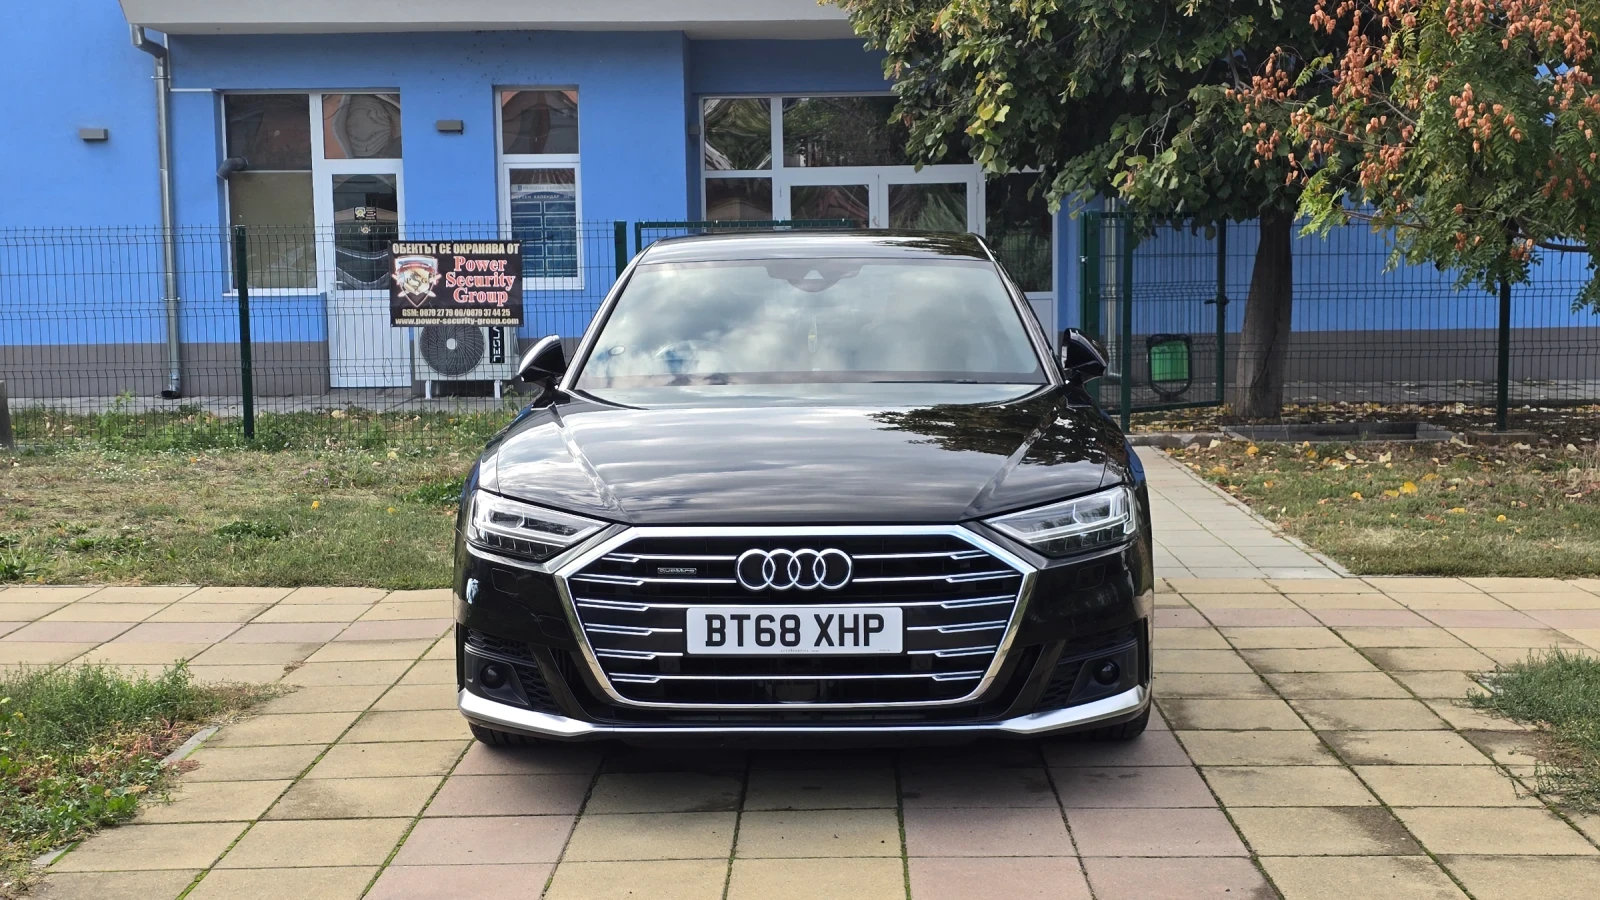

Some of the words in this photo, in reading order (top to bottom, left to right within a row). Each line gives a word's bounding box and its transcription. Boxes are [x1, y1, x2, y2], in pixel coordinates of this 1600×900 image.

[392, 243, 437, 254] ОБЕКТЪТ
[439, 243, 452, 254] СЕ
[453, 243, 505, 254] ОХРАНЯВА
[507, 243, 520, 254] ОТ
[453, 256, 508, 272] Power
[445, 271, 516, 292] Security
[453, 287, 509, 307] Group
[402, 308, 419, 317] GSM:
[419, 308, 436, 317] 0879
[437, 308, 445, 317] 27
[445, 308, 453, 317] 79
[484, 308, 492, 317] 37
[492, 308, 501, 317] 44
[501, 308, 511, 317] 25
[395, 317, 519, 325] www.power-security-group.com
[705, 614, 801, 647] BT68
[813, 613, 885, 647] XHP
